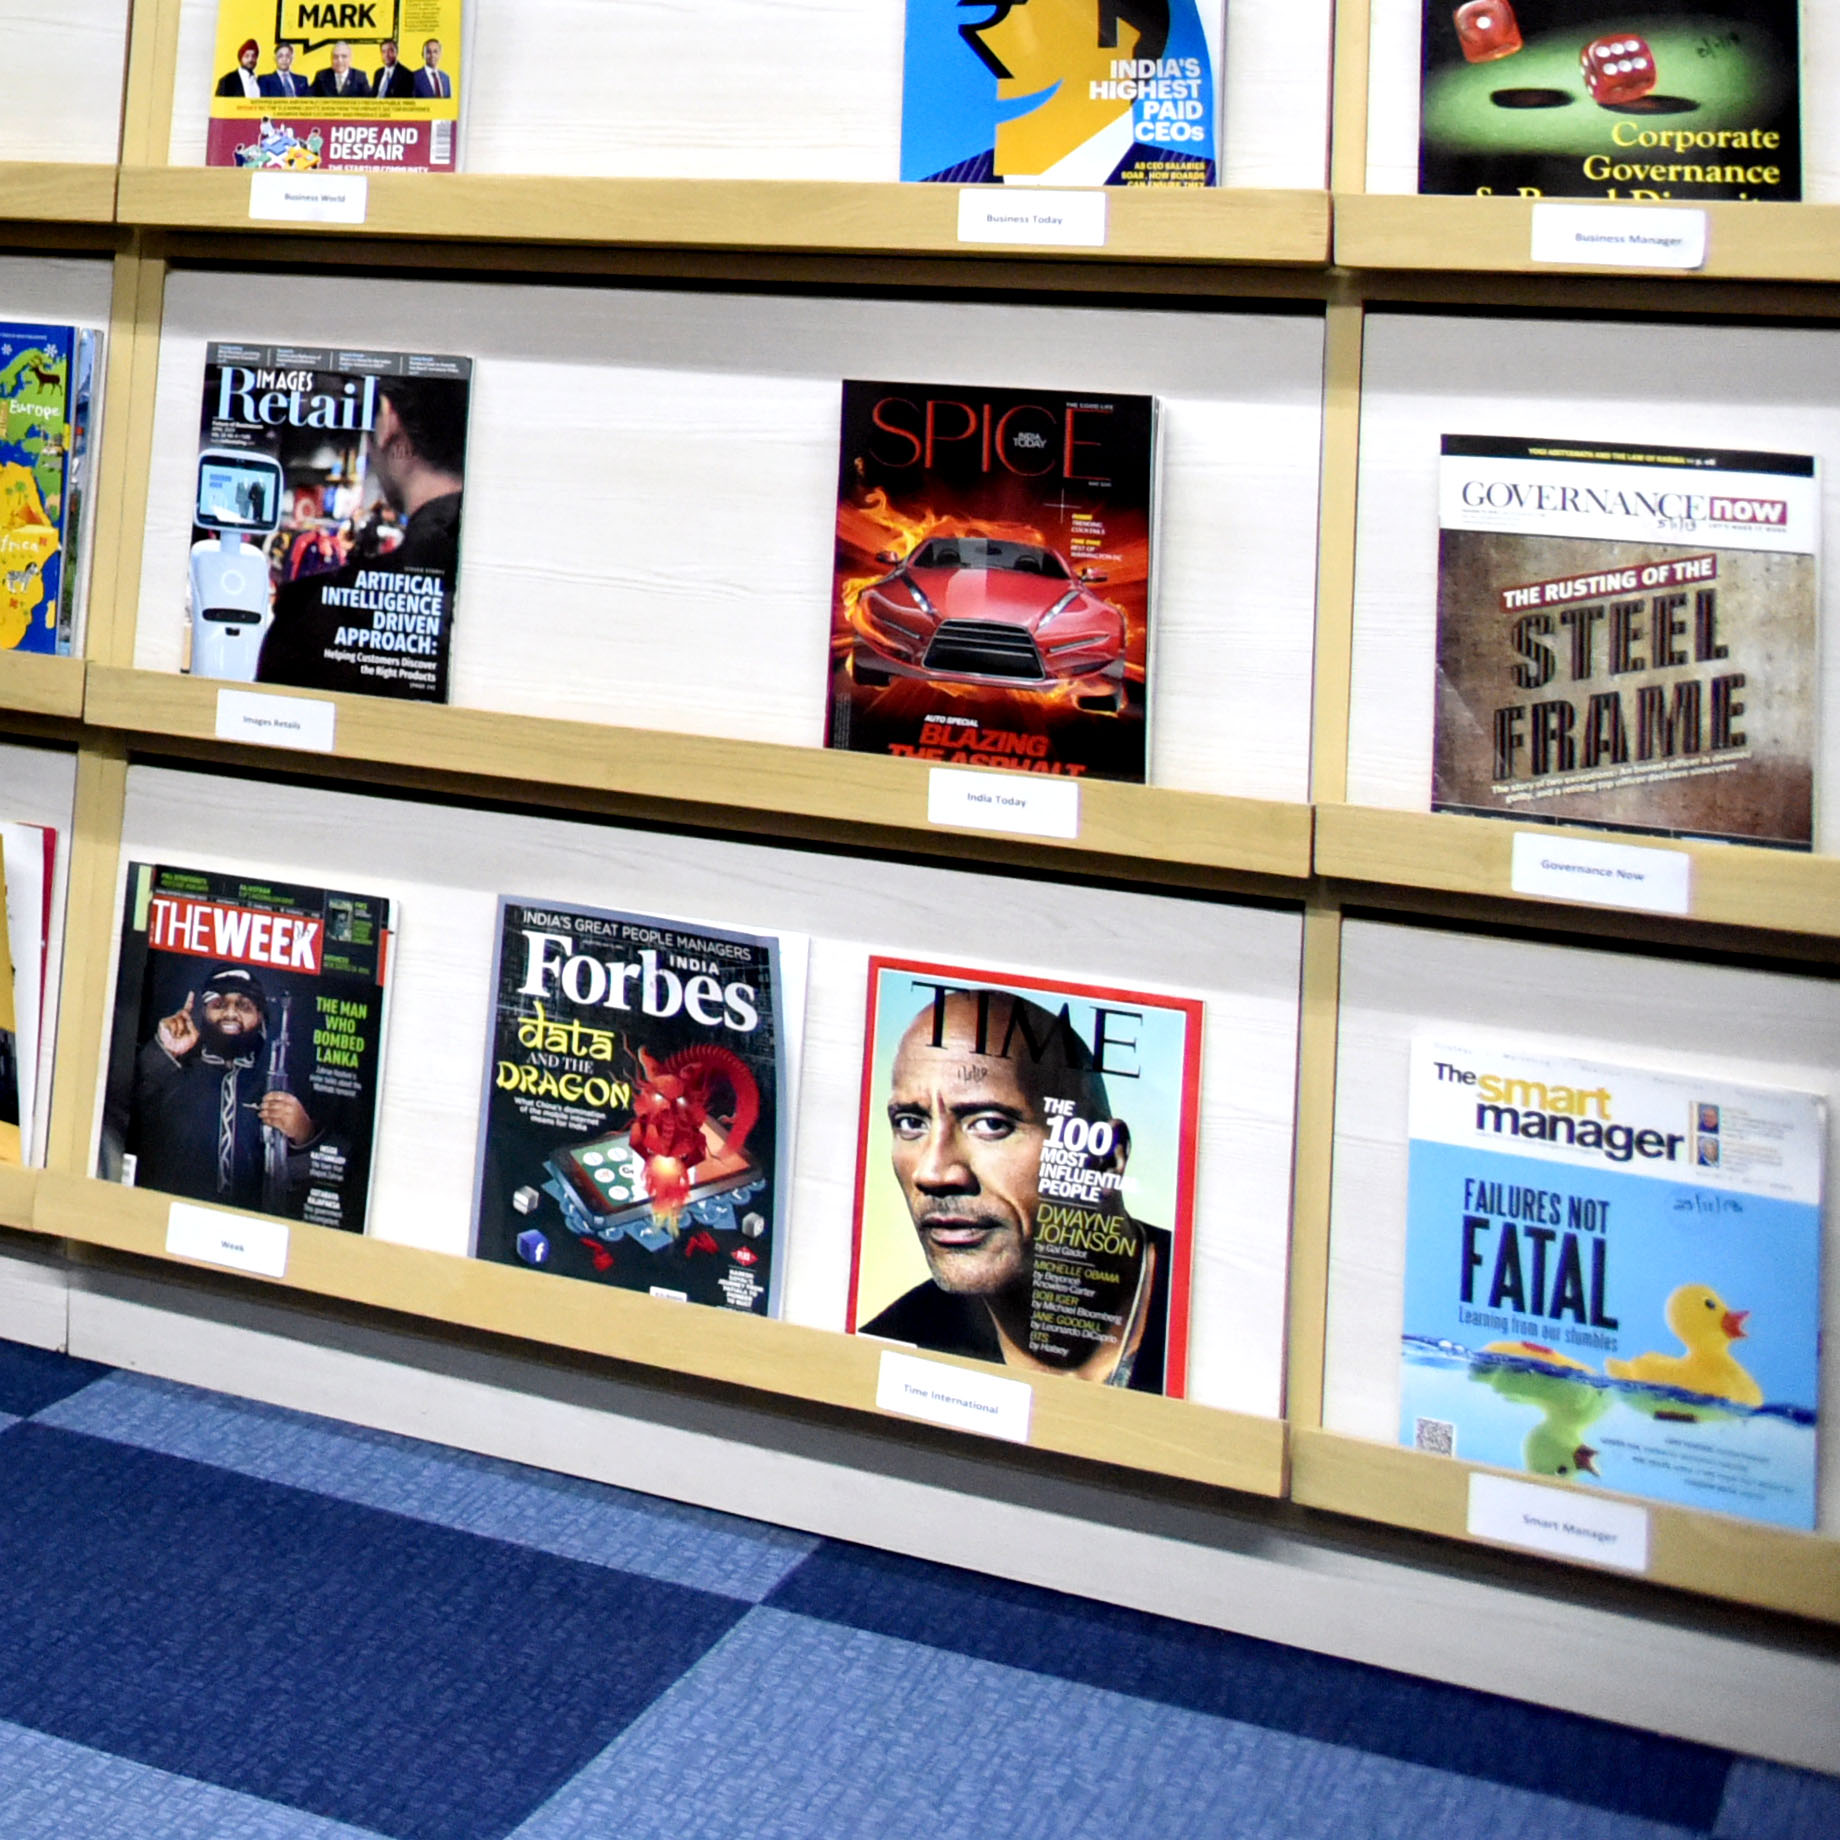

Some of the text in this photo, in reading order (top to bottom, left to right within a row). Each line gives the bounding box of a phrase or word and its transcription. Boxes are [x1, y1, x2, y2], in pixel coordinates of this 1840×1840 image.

[298, 3, 376, 29] MARK
[1110, 59, 1201, 79] INDIA'S
[1089, 79, 1202, 99] HIGHEST
[1143, 100, 1203, 120] PAID
[330, 126, 419, 144] HOPE AND
[1135, 121, 1205, 142] CEOs
[1611, 121, 1780, 152] Corporate
[330, 144, 404, 160] DESPAIR
[1583, 154, 1780, 184] Governance
[1033, 215, 1064, 226] Today
[256, 369, 314, 392] IMAGES
[10, 399, 60, 420] Europe
[217, 366, 381, 432] Retail
[869, 396, 1114, 481] SPICE
[1462, 480, 1783, 523] GOVERNANCE now
[1503, 557, 1713, 609] THE RUSTING OF THE
[321, 586, 442, 616] INTELLIGENCE
[372, 611, 440, 636] DRIVEN
[334, 626, 438, 655] APPROACH:
[1511, 588, 1730, 690] STEEL
[324, 648, 438, 670] Helping Customers Discover
[376, 666, 398, 679] Right
[399, 669, 436, 682] Products
[947, 716, 979, 728] SPECIAL
[1491, 673, 1747, 782] FRAME
[919, 723, 1049, 758] BLAZING
[967, 792, 1026, 808] India Today
[1540, 859, 1645, 883] Governance Now
[152, 898, 318, 970] THE WEEK
[523, 911, 752, 961] INDIA'S GREAT PEOPLE MANAGERS
[669, 954, 720, 975] INDIA
[517, 930, 758, 1032] Forbes
[316, 996, 367, 1020] THE MAN
[325, 1015, 356, 1034] WHO
[518, 1000, 615, 1061] data
[910, 980, 1144, 1079] TIME
[313, 1029, 365, 1053] BOMBED
[316, 1046, 359, 1068] LANKA
[527, 1052, 594, 1075] AND THE
[496, 1061, 630, 1110] DRAGON
[1434, 1062, 1476, 1086] The
[1043, 1096, 1075, 1116] THE
[1476, 1074, 1611, 1120] smart
[1042, 1115, 1113, 1156] 100
[1475, 1103, 1685, 1162] manager
[1040, 1147, 1088, 1167] MOST
[1038, 1178, 1101, 1203] PEOPLE
[1464, 1178, 1610, 1234] FAILURES NOT
[1036, 1204, 1124, 1235] DWAYNE
[1034, 1223, 1137, 1257] JOHNSON
[1034, 1260, 1120, 1284] MICHELLE OBAMA
[1459, 1215, 1619, 1331] FATAL
[1459, 1306, 1538, 1337] Learning from
[904, 1382, 999, 1415] Time International
